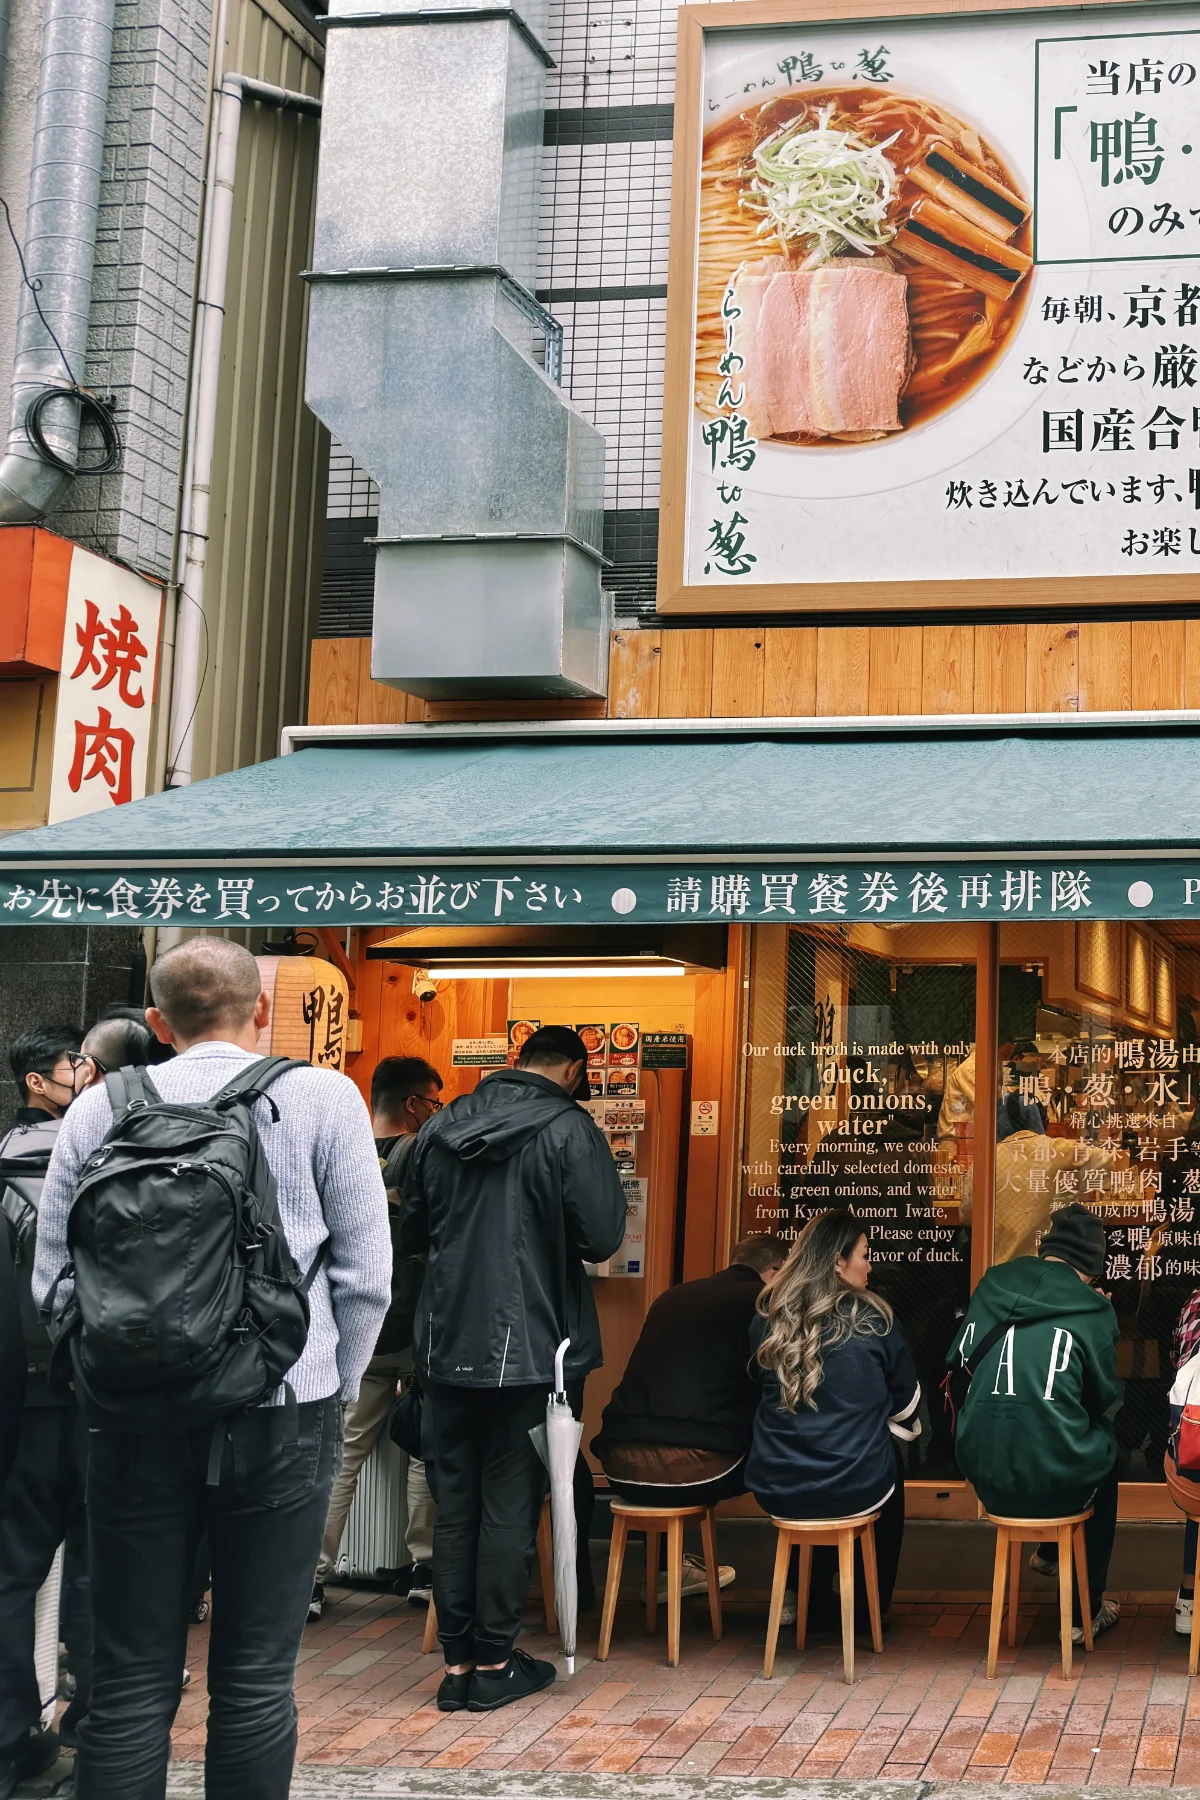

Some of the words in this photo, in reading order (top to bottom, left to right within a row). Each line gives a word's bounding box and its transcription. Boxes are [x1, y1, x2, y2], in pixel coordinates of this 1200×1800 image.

[68, 599, 149, 806] 焼肉
[4, 874, 583, 920] お先に食券を買ってからお並び下さい
[667, 870, 1093, 916] 請購買餐券後再排隊
[742, 1042, 769, 1056] Our
[774, 1042, 806, 1056] duck
[811, 1042, 848, 1056] broth
[852, 1041, 863, 1056] is
[868, 1041, 904, 1055] made
[909, 1041, 939, 1055] with
[943, 1041, 972, 1057] only
[770, 1094, 837, 1115] green
[848, 1088, 933, 1113] onions,
[817, 1114, 894, 1136] water"
[1069, 1112, 1176, 1129] 精心挑選來自
[769, 1139, 811, 1155] Every
[816, 1139, 878, 1155] morning,
[884, 1142, 904, 1152] we
[908, 1138, 939, 1152] cook
[742, 1161, 773, 1175] with
[777, 1160, 839, 1176] carefully
[844, 1160, 899, 1174] selected
[904, 1160, 965, 1174] domestic
[748, 1183, 785, 1198] duck,
[791, 1186, 830, 1199] green
[834, 1182, 882, 1197] onions,
[887, 1182, 911, 1196] and
[917, 1184, 957, 1196] water
[755, 1205, 789, 1219] from
[905, 1203, 948, 1219] Iwate,
[869, 1225, 913, 1240] Please
[918, 1225, 955, 1242] enjoy
[908, 1248, 922, 1262] of
[926, 1248, 963, 1262] duck.
